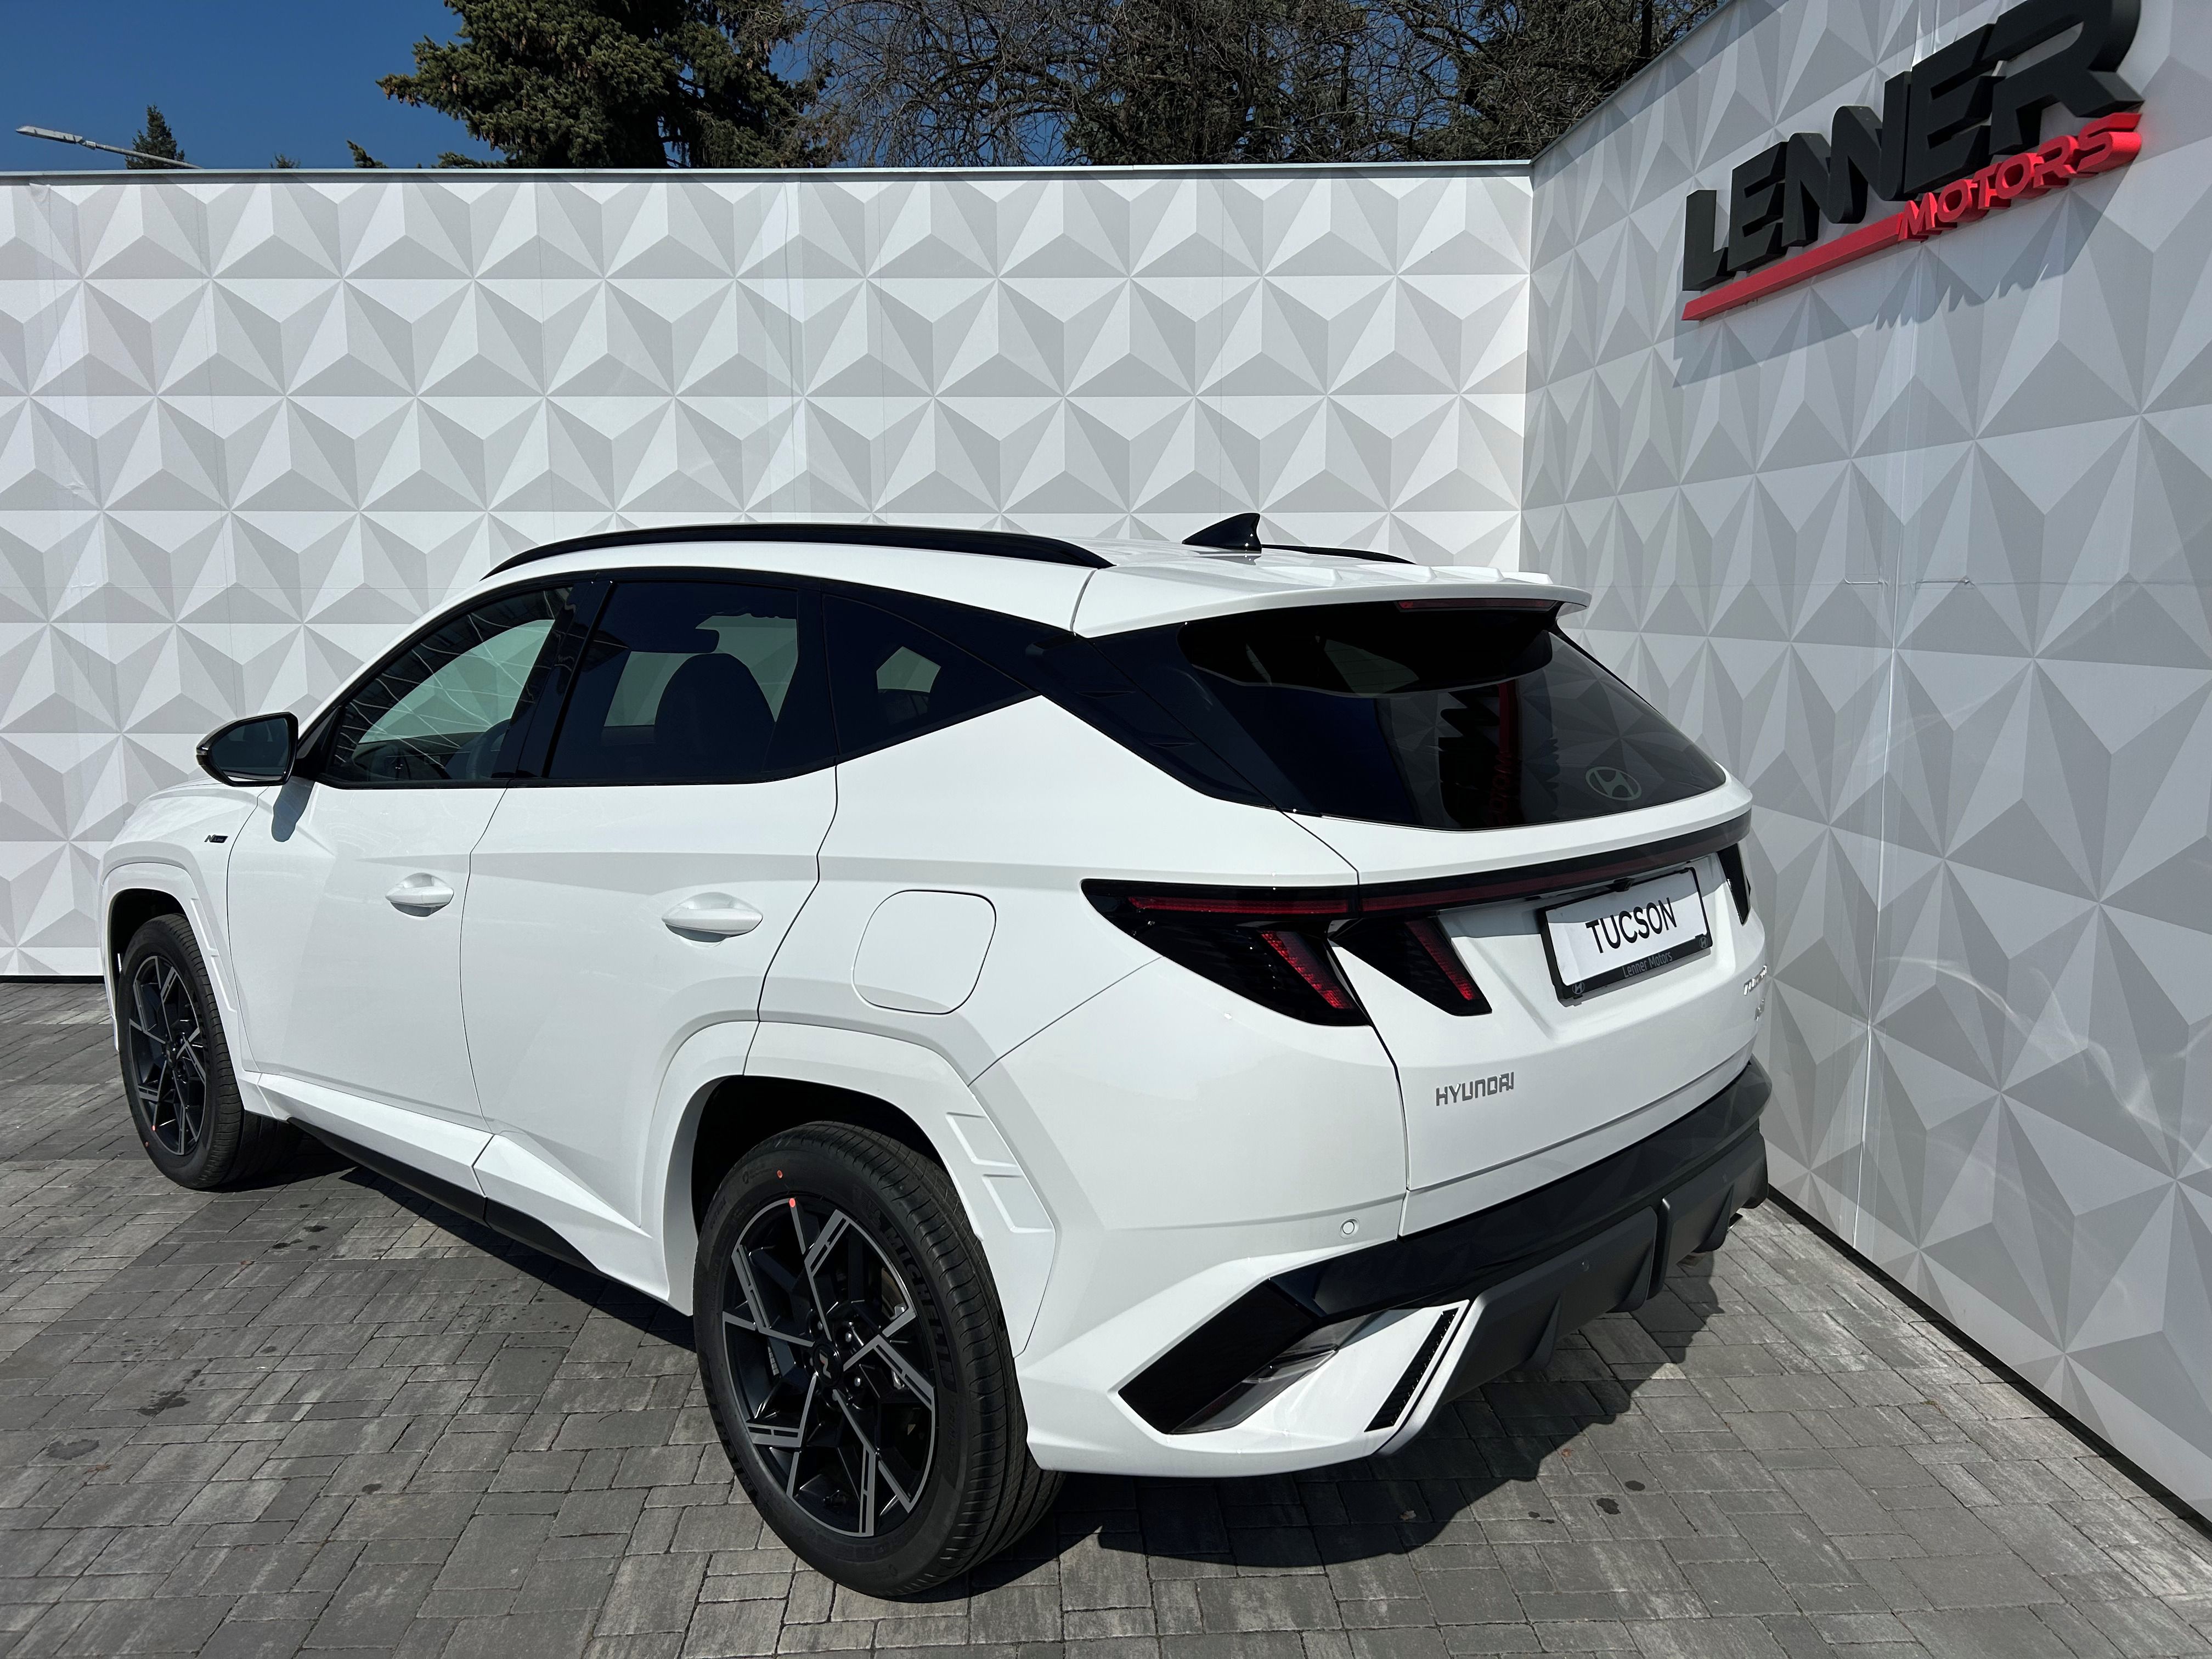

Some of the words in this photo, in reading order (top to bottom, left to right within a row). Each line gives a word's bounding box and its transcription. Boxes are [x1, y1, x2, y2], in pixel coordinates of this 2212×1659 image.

[1683, 0, 2145, 291] LENNER
[1899, 112, 2141, 242] MOTORS
[1585, 897, 1677, 954] TUCSON
[1622, 960, 1647, 978] Lenner
[1648, 951, 1673, 969] Motors
[1436, 1071, 1514, 1106] HYUNDAI
[884, 1226, 955, 1384] MICHELIN
